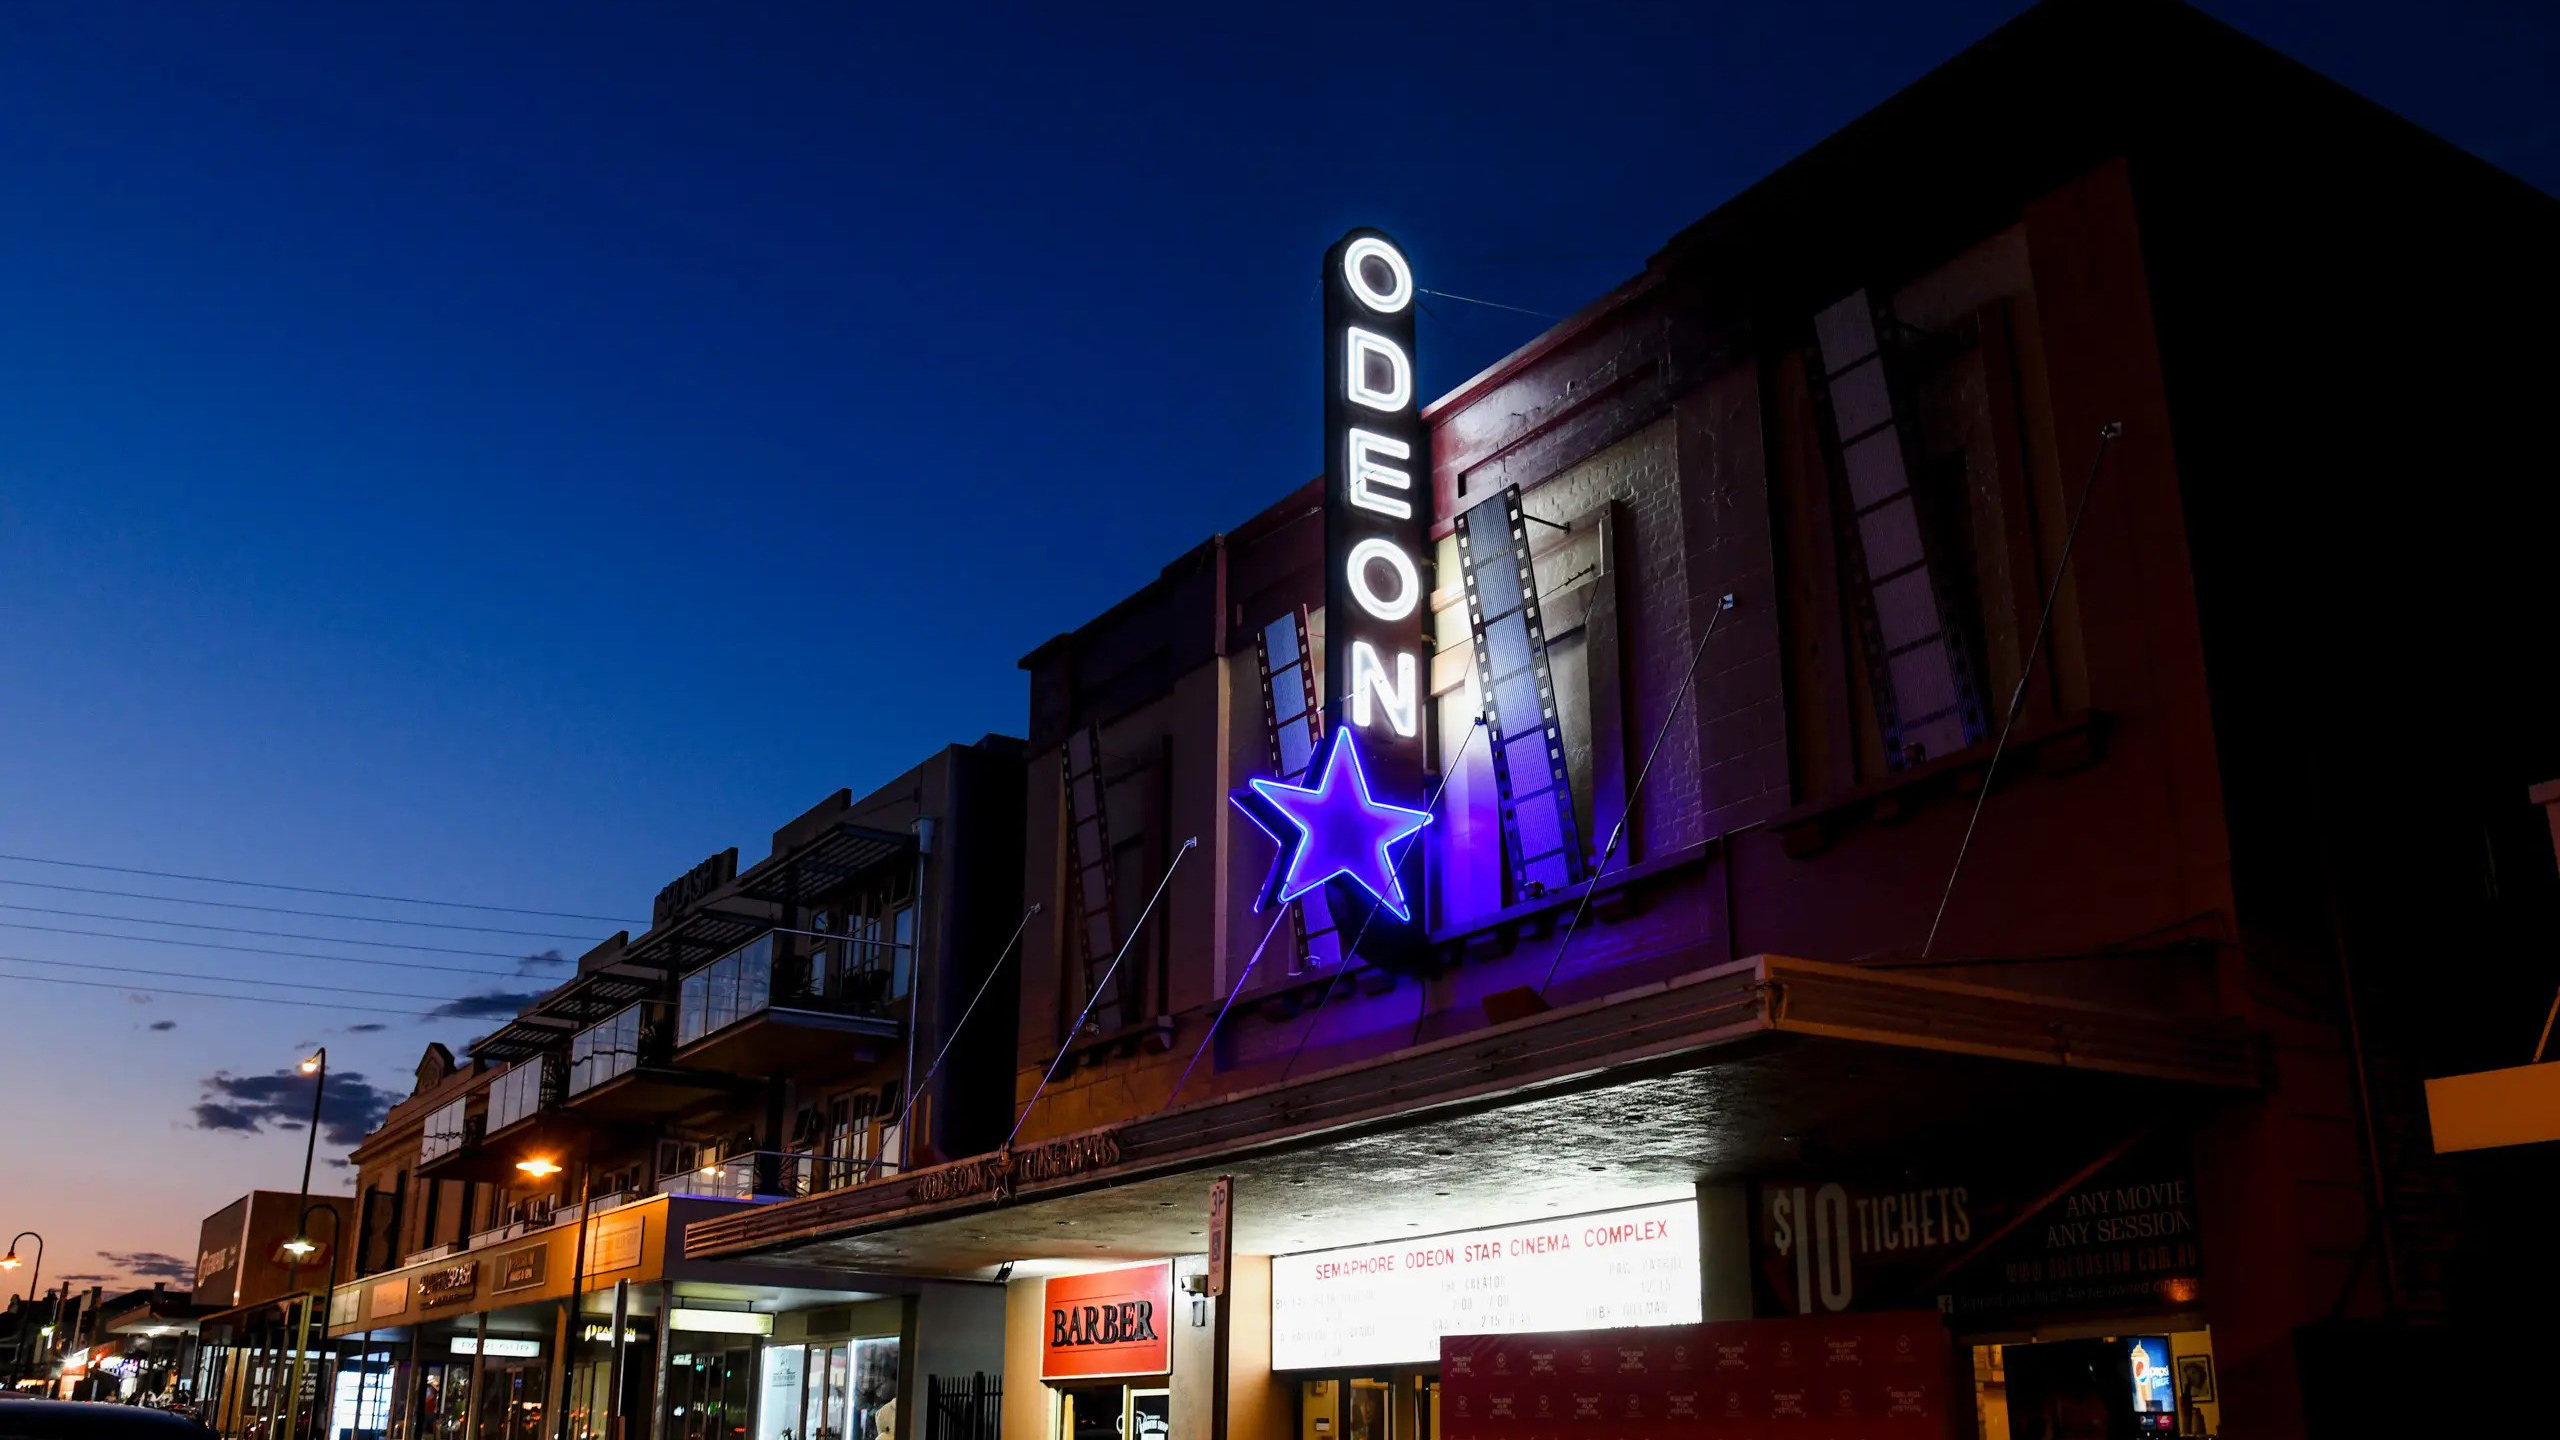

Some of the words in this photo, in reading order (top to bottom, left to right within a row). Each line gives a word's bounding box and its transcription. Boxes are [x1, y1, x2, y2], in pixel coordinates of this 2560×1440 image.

[1344, 237, 1420, 738] ODEON
[2066, 1190, 2111, 1219] ANY
[2115, 1180, 2190, 1212] MOVIE
[1315, 1255, 1395, 1281] SEMAPHORE
[1405, 1247, 1455, 1269] ODEON
[1464, 1241, 1502, 1263] STAR
[1510, 1233, 1571, 1257] CINEMA
[1584, 1219, 1669, 1248] COMPLEX
[1773, 1182, 1854, 1315] $10
[1857, 1185, 1971, 1254] TICKETS
[2046, 1222, 2091, 1248] ANY
[2097, 1210, 2193, 1242] SESSION
[1051, 1300, 1158, 1348] BARBER
